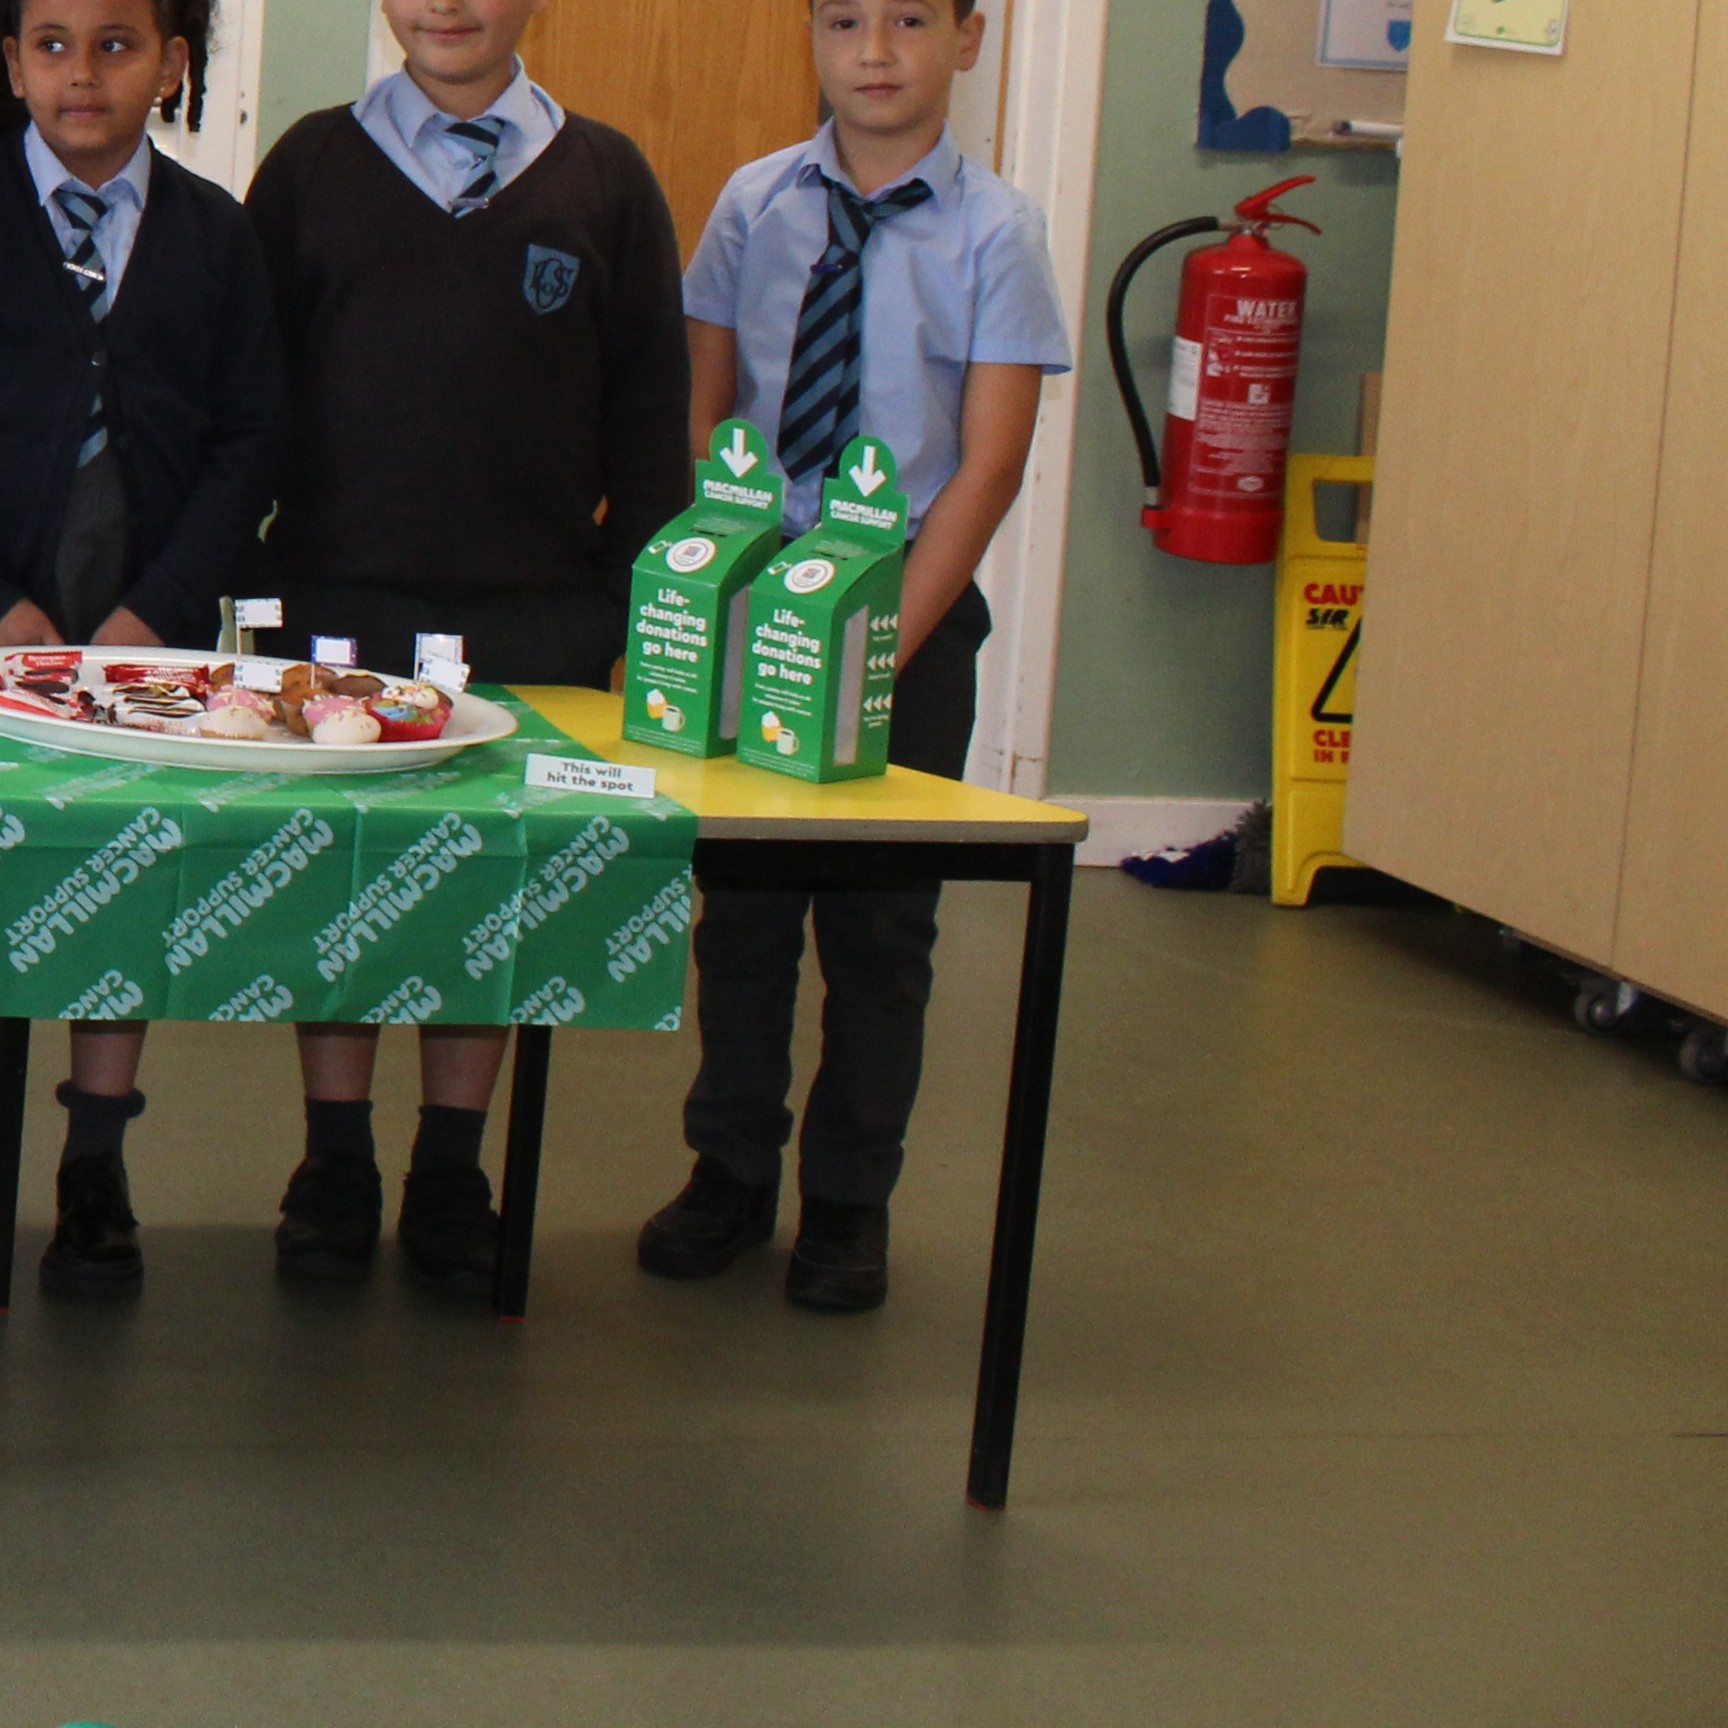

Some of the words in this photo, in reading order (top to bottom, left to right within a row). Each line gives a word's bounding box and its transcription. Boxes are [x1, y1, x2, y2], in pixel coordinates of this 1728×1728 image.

[703, 479, 773, 502] MACMILLAN
[830, 499, 898, 521] MACMILLAN
[640, 603, 706, 631] changing
[658, 588, 690, 606] Life-
[773, 609, 805, 627] Life-
[636, 619, 708, 647] donations
[643, 641, 662, 656] go
[665, 642, 698, 663] here
[752, 640, 822, 669] donations
[755, 623, 820, 653] changing
[757, 662, 776, 677] go
[779, 664, 812, 685] here
[546, 772, 567, 784] hit
[572, 774, 596, 787] the
[600, 780, 633, 791] spot
[562, 762, 591, 774] This
[595, 766, 622, 778] will
[85, 806, 160, 871] CANCER
[240, 808, 313, 876] CANCER
[388, 812, 461, 878] CANCER
[540, 815, 609, 881] CANCER
[5, 867, 89, 946] SUPPORT
[9, 818, 183, 973] MACMILLAN
[162, 871, 242, 948] SUPPORT
[165, 819, 334, 974] MACMILLAN
[313, 873, 392, 954] SUPPORT
[317, 823, 482, 982] MACMILLAN
[462, 877, 541, 955] SUPPORT
[464, 826, 630, 981] MACMILLAN
[605, 877, 687, 956] SUPPORT
